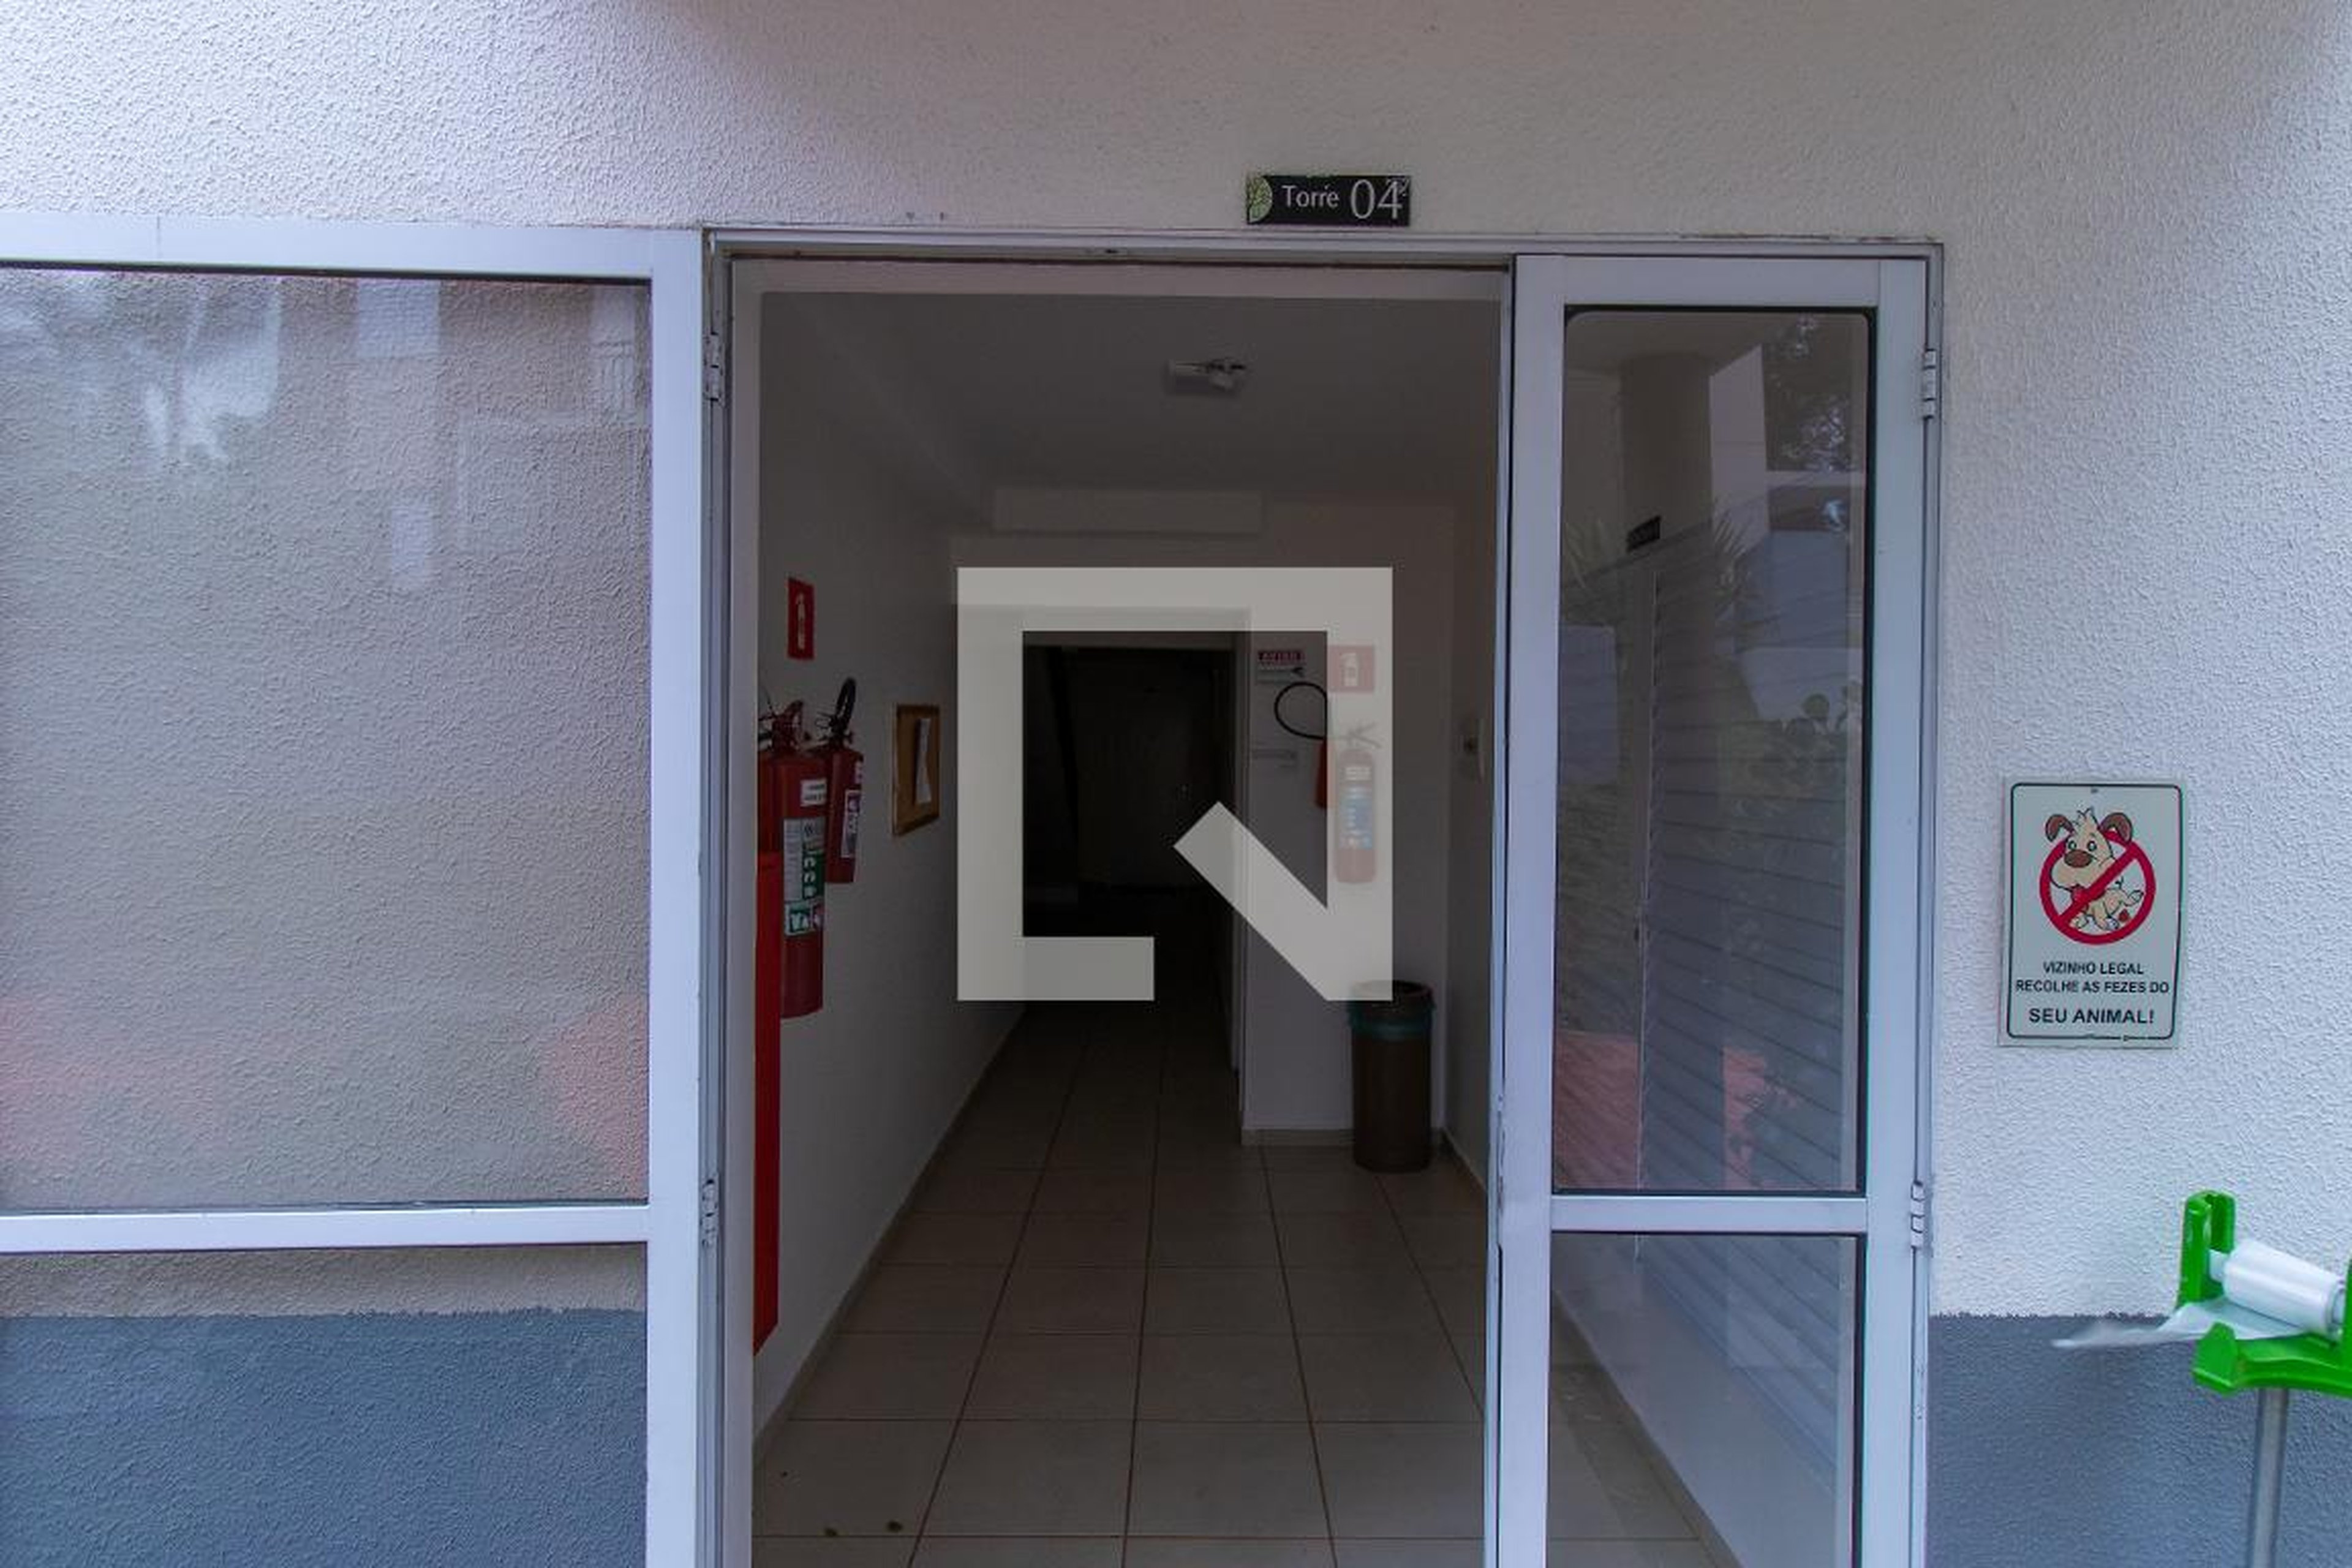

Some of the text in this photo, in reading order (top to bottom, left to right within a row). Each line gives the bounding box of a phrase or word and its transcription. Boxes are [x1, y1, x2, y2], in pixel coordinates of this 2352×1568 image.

[1282, 179, 1403, 219] Torre 04
[2043, 961, 2144, 974] VIZINHO LEGAL
[2016, 980, 2169, 993] RECOLHE AS FEZES DO
[2029, 1008, 2154, 1023] SEU ANIMAL!
